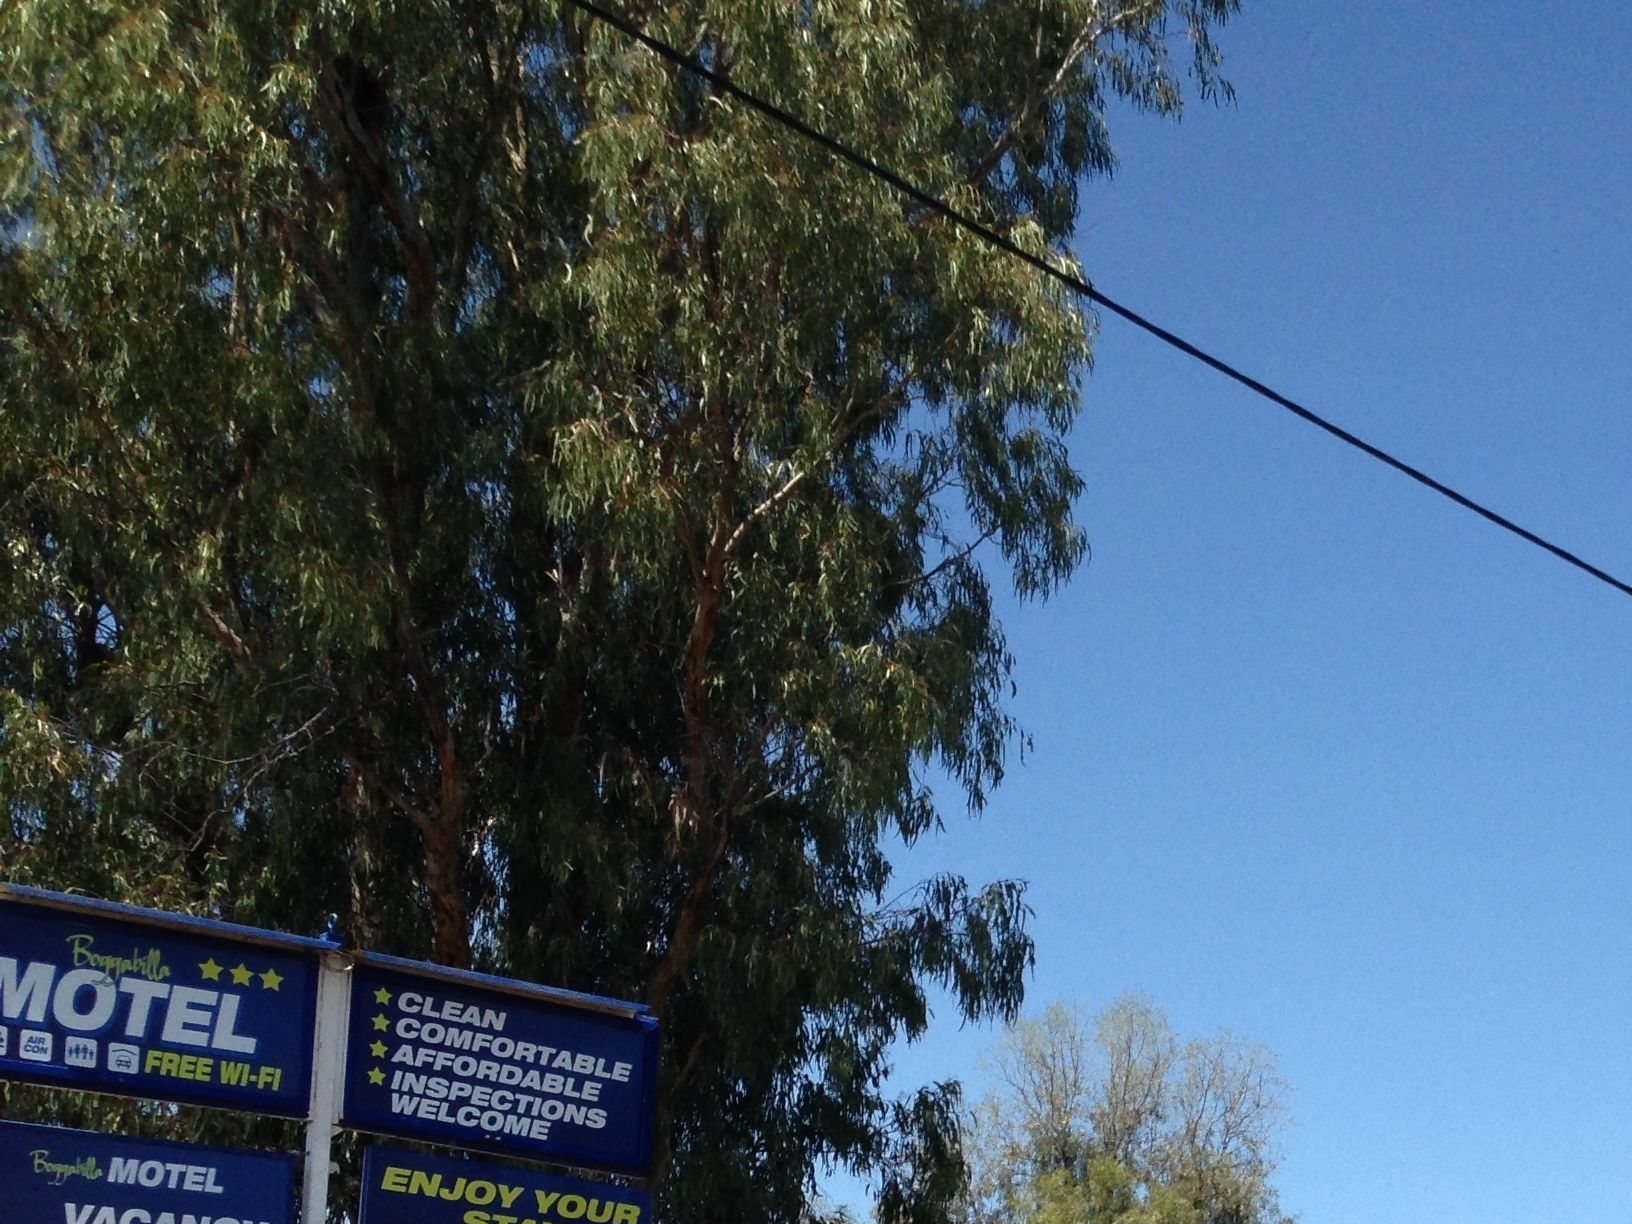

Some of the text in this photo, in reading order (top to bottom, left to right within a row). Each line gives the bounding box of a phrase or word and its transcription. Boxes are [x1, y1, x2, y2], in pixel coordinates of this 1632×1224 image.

[0, 956, 256, 1054] MOTEL
[397, 992, 507, 1031] CLEAN
[23, 1043, 48, 1055] CON
[26, 1035, 46, 1046] AIR
[395, 1018, 632, 1082] COMFORTABLE
[145, 1050, 282, 1091] FREE WI-FI
[391, 1044, 602, 1101] AFFORDABLE
[390, 1070, 608, 1129] INSPECTIONS
[390, 1093, 552, 1140] WELCOME
[107, 1157, 223, 1193] MOTEL
[381, 1166, 524, 1208] ENJOY
